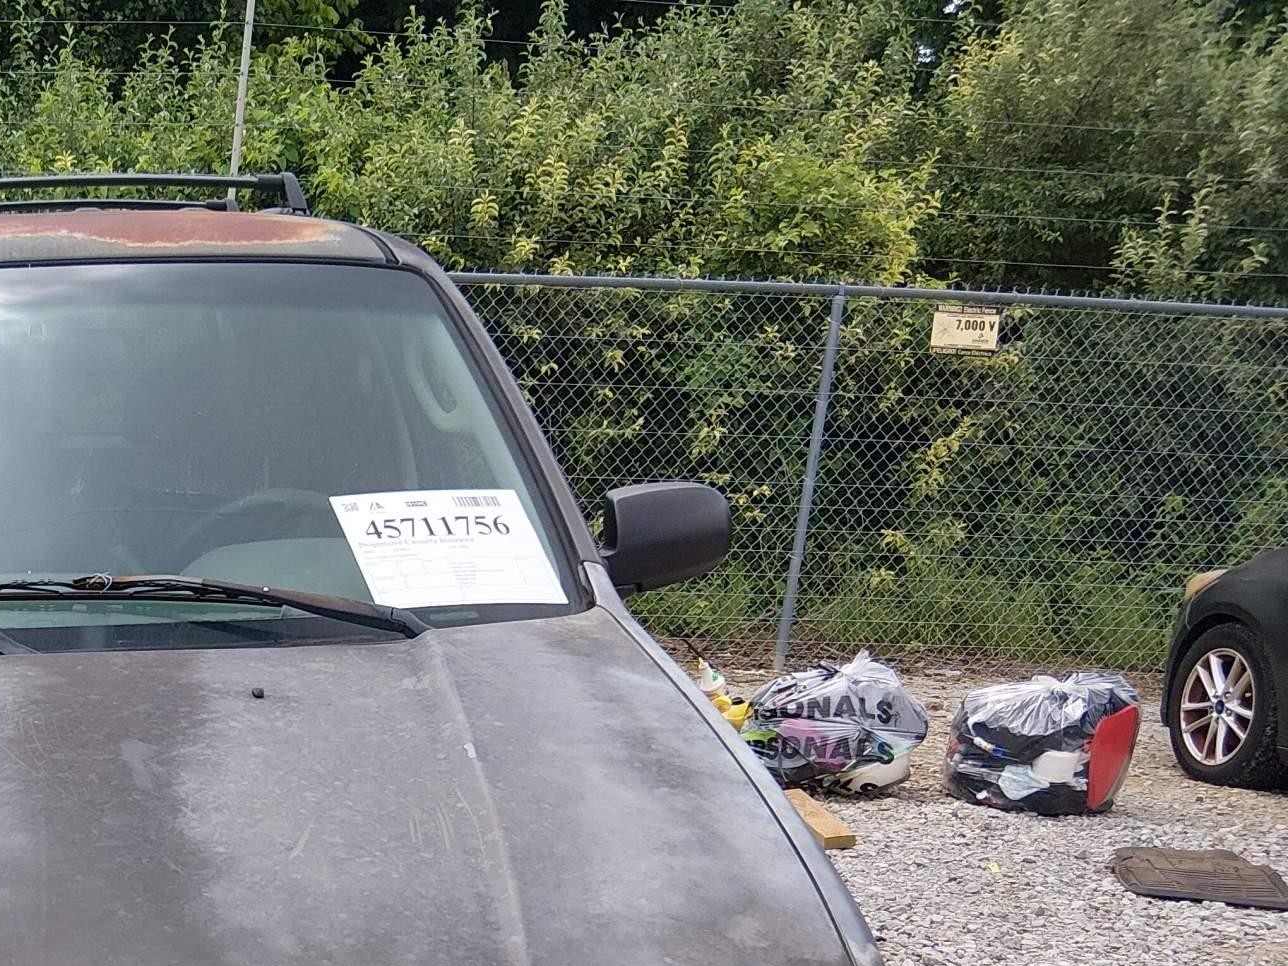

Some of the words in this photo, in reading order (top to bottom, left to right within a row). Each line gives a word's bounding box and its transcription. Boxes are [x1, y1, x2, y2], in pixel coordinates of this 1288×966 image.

[956, 319, 986, 332] 7,000
[989, 321, 996, 332] V
[365, 514, 511, 539] 45711756
